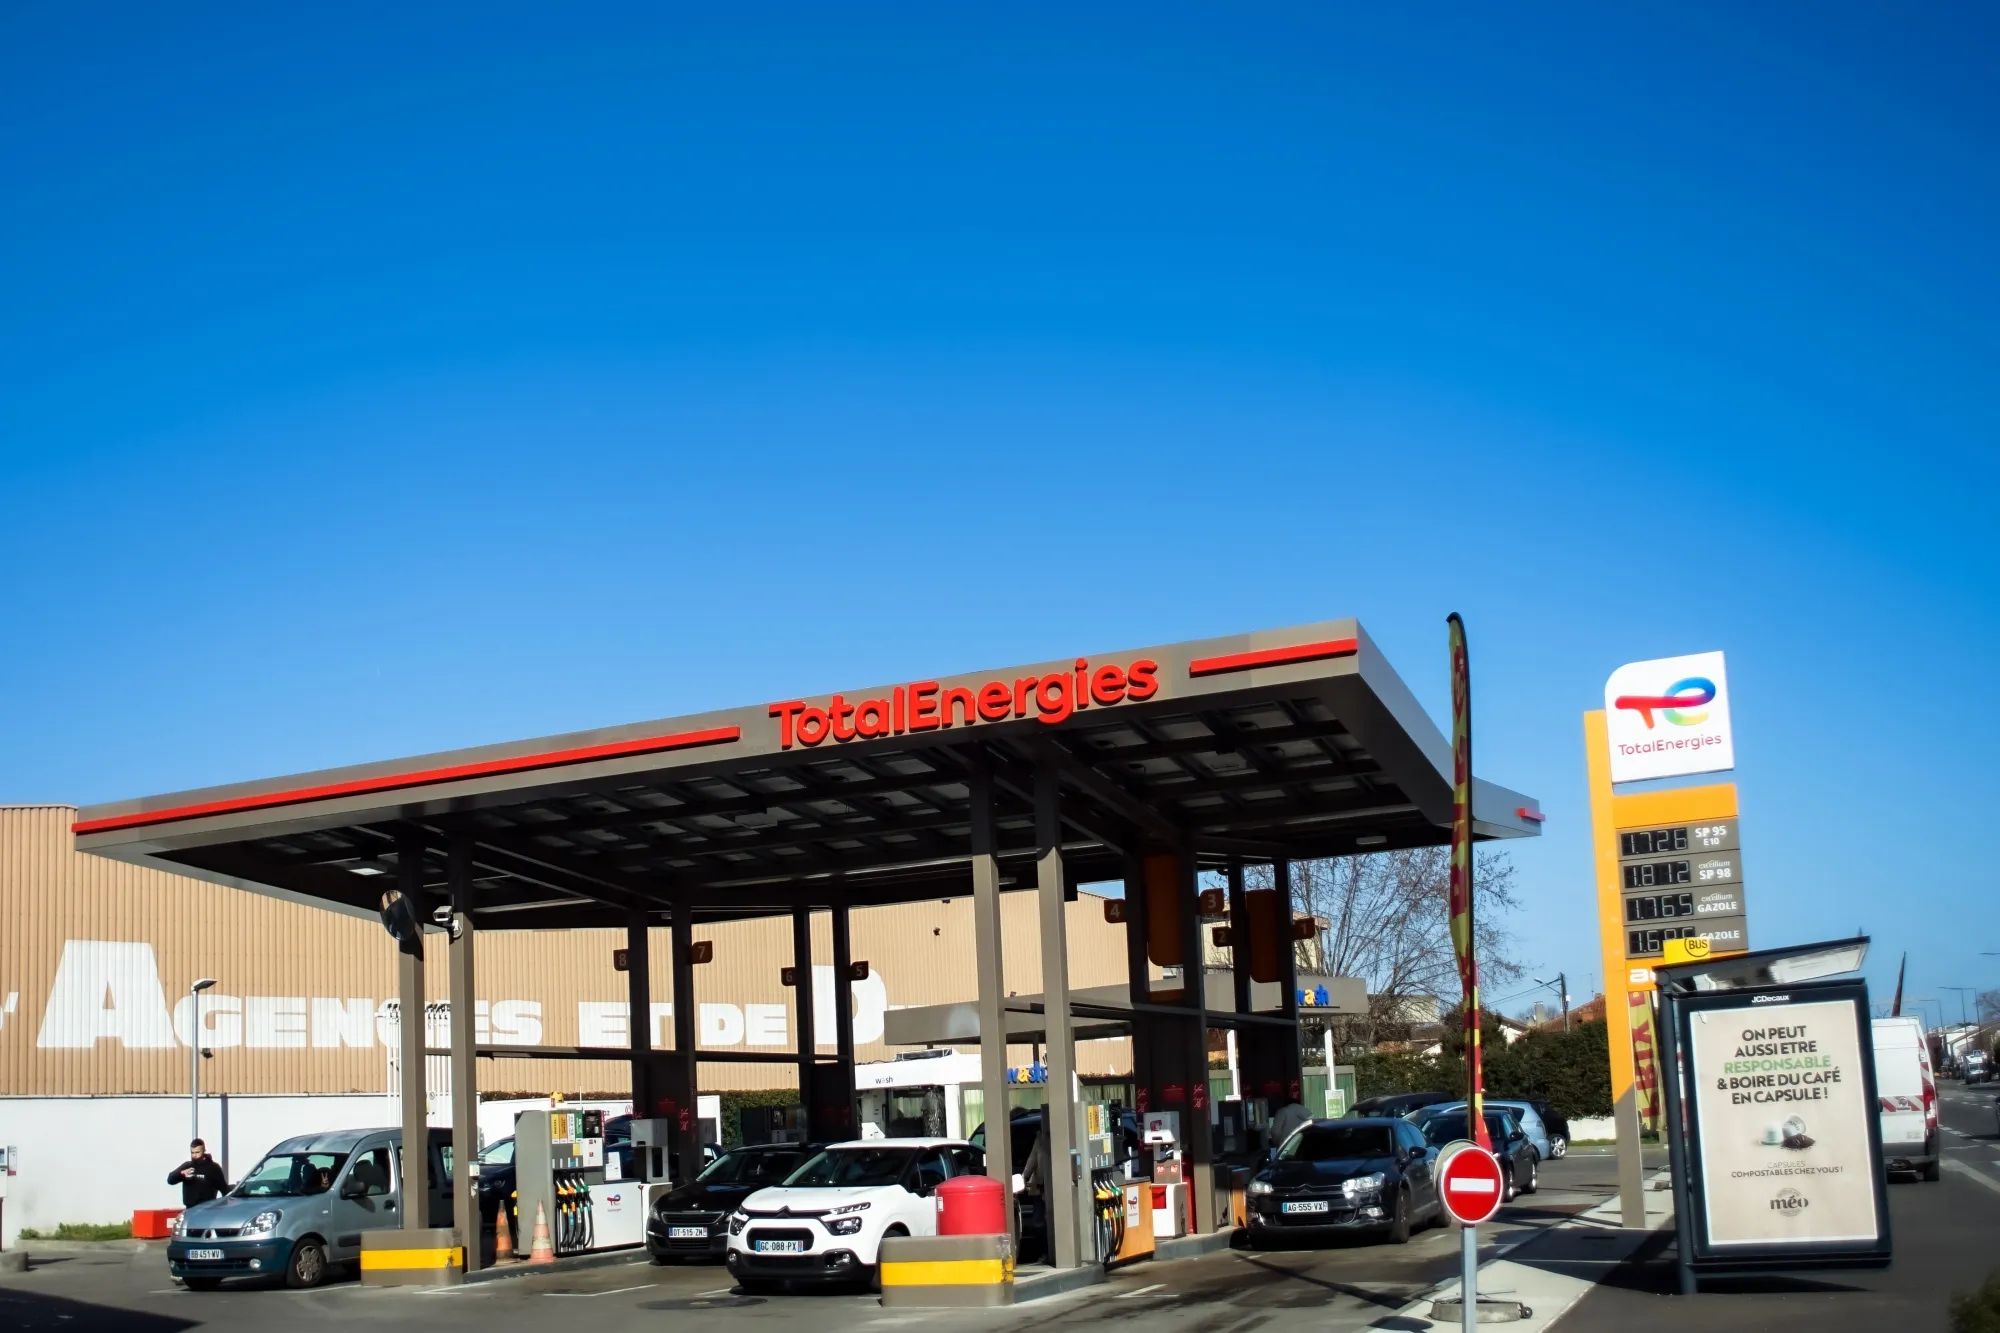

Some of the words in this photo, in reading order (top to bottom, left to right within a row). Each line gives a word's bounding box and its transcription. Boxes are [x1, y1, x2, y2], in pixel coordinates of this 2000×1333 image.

[768, 657, 1159, 750] TotalEnergies
[1618, 734, 1722, 755] TotalEnergies
[1695, 828, 1710, 838] SP
[1712, 826, 1727, 836] 95
[1631, 829, 1688, 854] 1.726
[1703, 837, 1720, 846] E10
[1633, 861, 1689, 886] 1.812
[1699, 869, 1714, 880] SP
[1716, 867, 1731, 879] 98
[1110, 904, 1120, 918] 4
[1636, 893, 1693, 919] 1.765
[1697, 902, 1737, 913] GAZOLE
[1688, 939, 1708, 950] BUS
[1752, 994, 1789, 1003] JCDecaux
[699, 1003, 787, 1046] DE
[1742, 1028, 1766, 1042] ON
[1768, 1025, 1806, 1040] PEUT
[1735, 1042, 1778, 1058] AUSSI
[1780, 1040, 1818, 1055] ETRE
[1724, 1055, 1832, 1074] RESPONSABLE
[1717, 1077, 1728, 1090] &
[1730, 1074, 1776, 1089] BOIRE
[1777, 1072, 1801, 1086] DU
[1802, 1066, 1842, 1084] CAFÉ
[1731, 1091, 1752, 1105] EN
[1753, 1087, 1822, 1103] CAPSULE
[1731, 1168, 1794, 1178] COMPOSTABLES
[1794, 1167, 1815, 1175] CHEZ
[1817, 1166, 1840, 1174] VOUS
[1767, 1160, 1806, 1169] CAPSULES
[1770, 1195, 1809, 1209] méo
